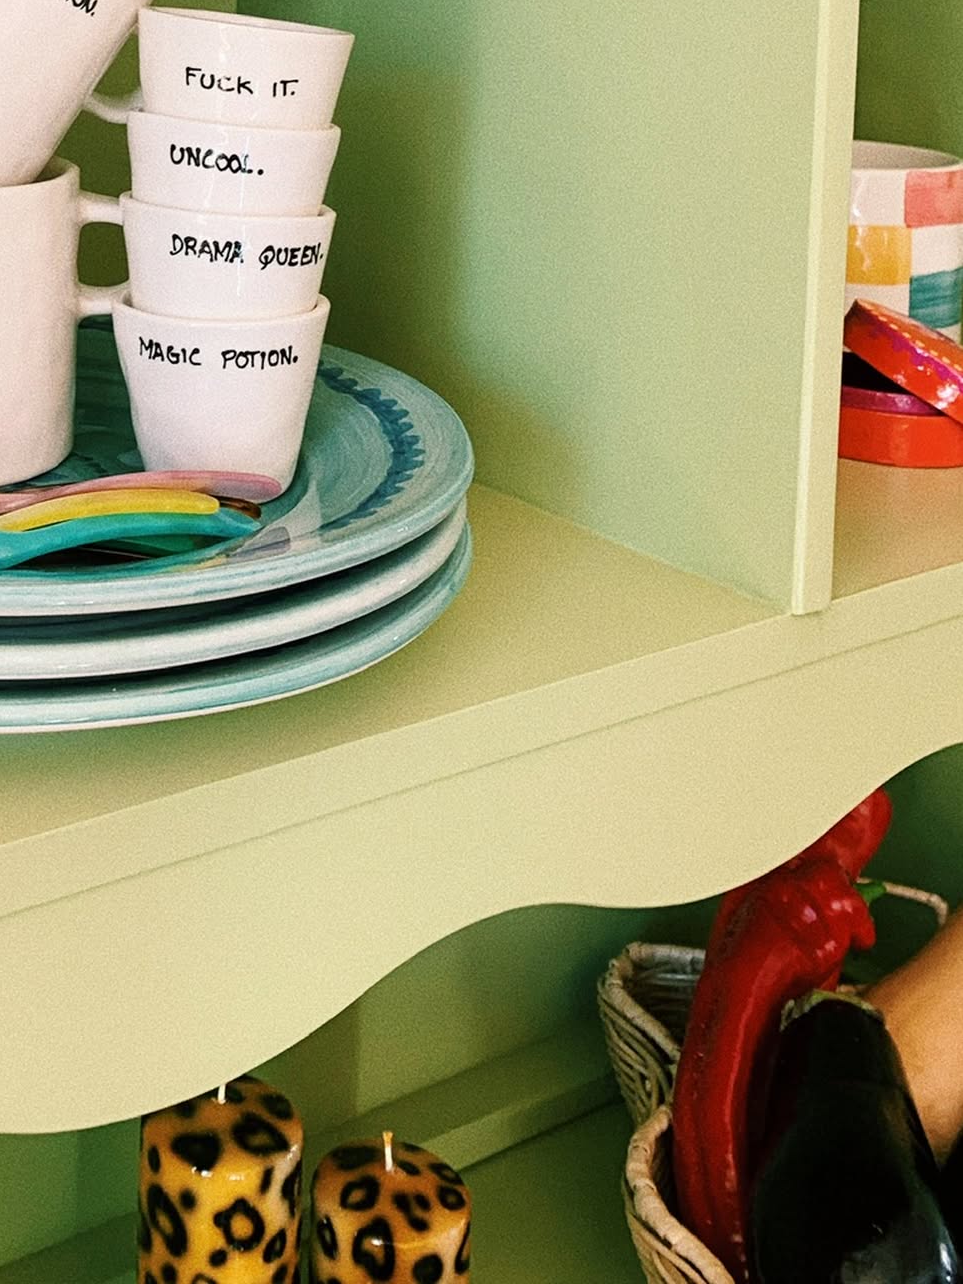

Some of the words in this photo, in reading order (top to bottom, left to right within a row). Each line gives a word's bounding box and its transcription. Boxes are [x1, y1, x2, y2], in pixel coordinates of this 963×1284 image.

[185, 66, 254, 95] FUCK
[272, 79, 300, 98] IT.
[169, 143, 264, 176] UNCOOL.
[169, 233, 245, 264] DRAMA
[258, 242, 324, 270] QUEEN.
[138, 336, 202, 366] MAGIC
[221, 345, 299, 370] POTION.
